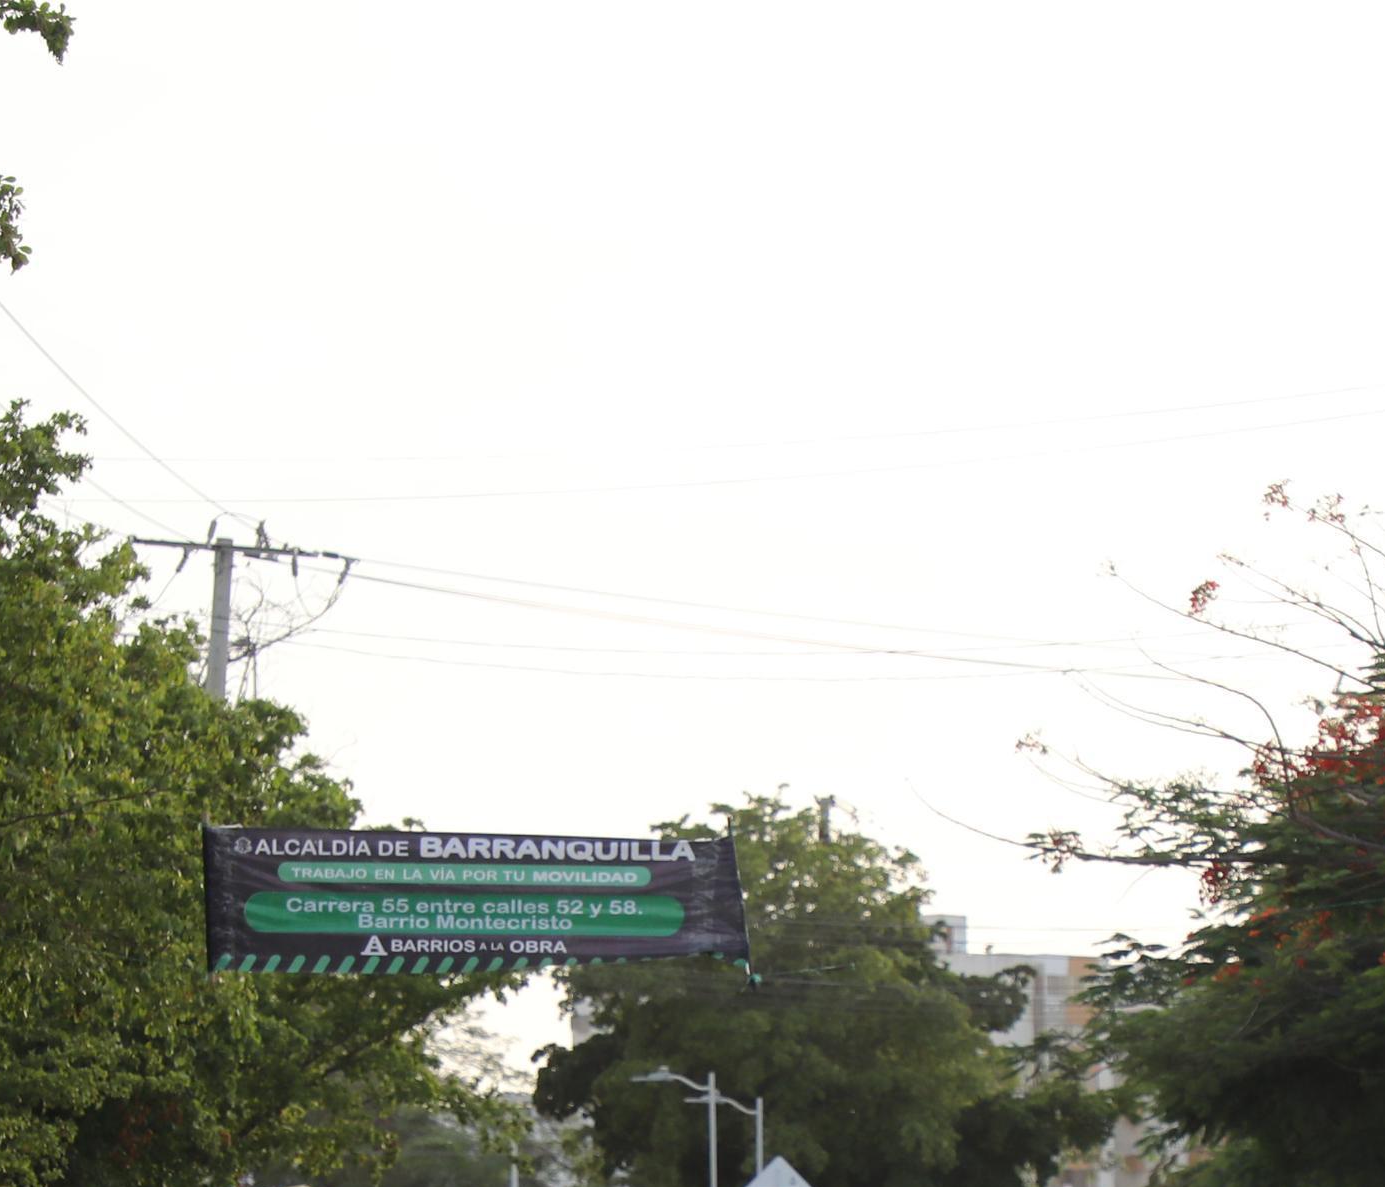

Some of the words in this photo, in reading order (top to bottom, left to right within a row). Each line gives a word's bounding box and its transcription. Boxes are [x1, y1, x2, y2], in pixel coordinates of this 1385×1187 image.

[255, 836, 372, 857] ALCALDÍA
[378, 840, 409, 857] DE
[420, 836, 696, 862] BARRANQUILLA
[291, 867, 367, 880] TRABAJO
[375, 868, 395, 880] EN
[403, 868, 422, 881] LA
[430, 866, 456, 881] VÍA
[463, 870, 497, 881] POR
[504, 870, 526, 882] TU
[533, 871, 637, 883] MOVILIDAD
[286, 898, 375, 913] Carrera
[382, 899, 409, 913] 55
[416, 900, 475, 914] entre
[483, 899, 549, 914] calles
[556, 900, 583, 915] 52
[590, 904, 603, 918] y
[609, 900, 643, 915] 58.
[358, 914, 429, 929] Barrio
[436, 915, 572, 930] Montecristo
[391, 939, 476, 953] BARRIOS
[479, 942, 487, 950] A
[491, 942, 505, 951] LA
[510, 940, 567, 954] OBRA
